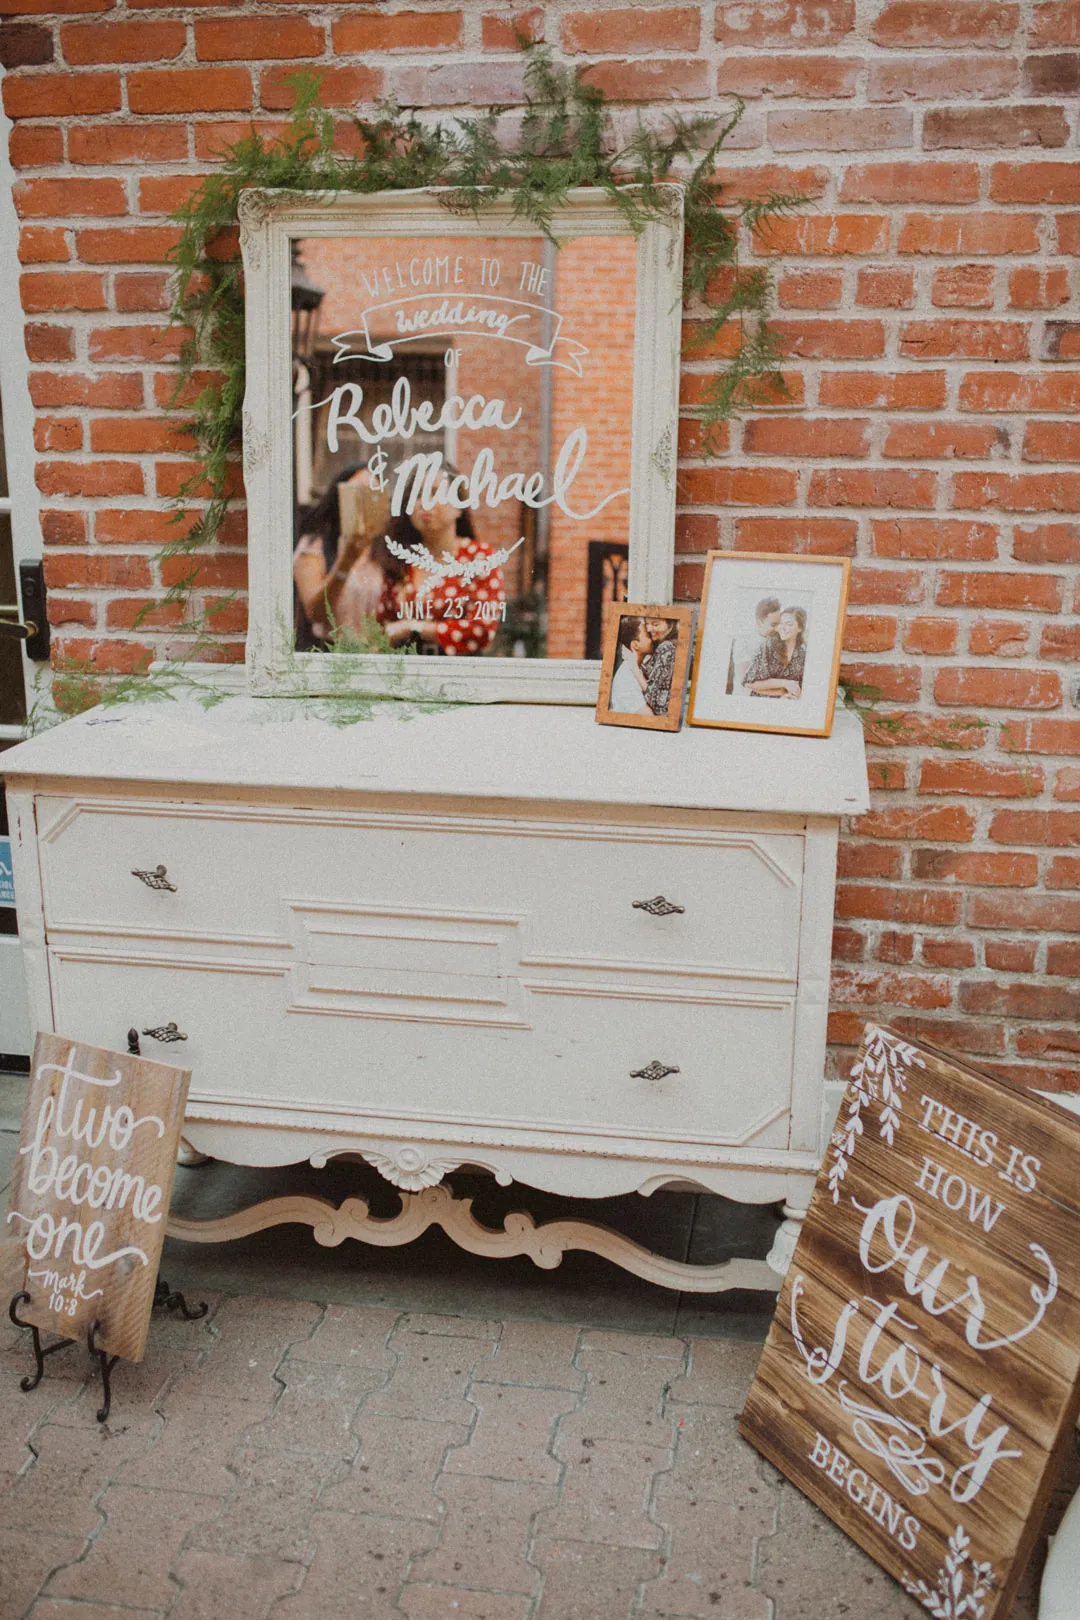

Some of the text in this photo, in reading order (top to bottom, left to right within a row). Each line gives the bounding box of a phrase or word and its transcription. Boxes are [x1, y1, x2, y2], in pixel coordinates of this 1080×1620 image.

[361, 255, 551, 297] WELCOME TO THE
[396, 300, 531, 337] wedding
[444, 347, 463, 368] OF
[291, 376, 522, 453] Rebecca
[368, 426, 631, 520] & Michael
[396, 599, 434, 620] JUNE
[474, 600, 507, 622] 2019
[37, 1047, 165, 1150] two
[20, 1095, 163, 1223] become
[918, 1094, 1041, 1193] THIS IS
[914, 1155, 1006, 1233] HOW
[7, 1211, 148, 1269] one
[851, 1194, 1058, 1350] Our
[48, 1293, 78, 1316] 10:8
[808, 1432, 920, 1550] BEGINS
